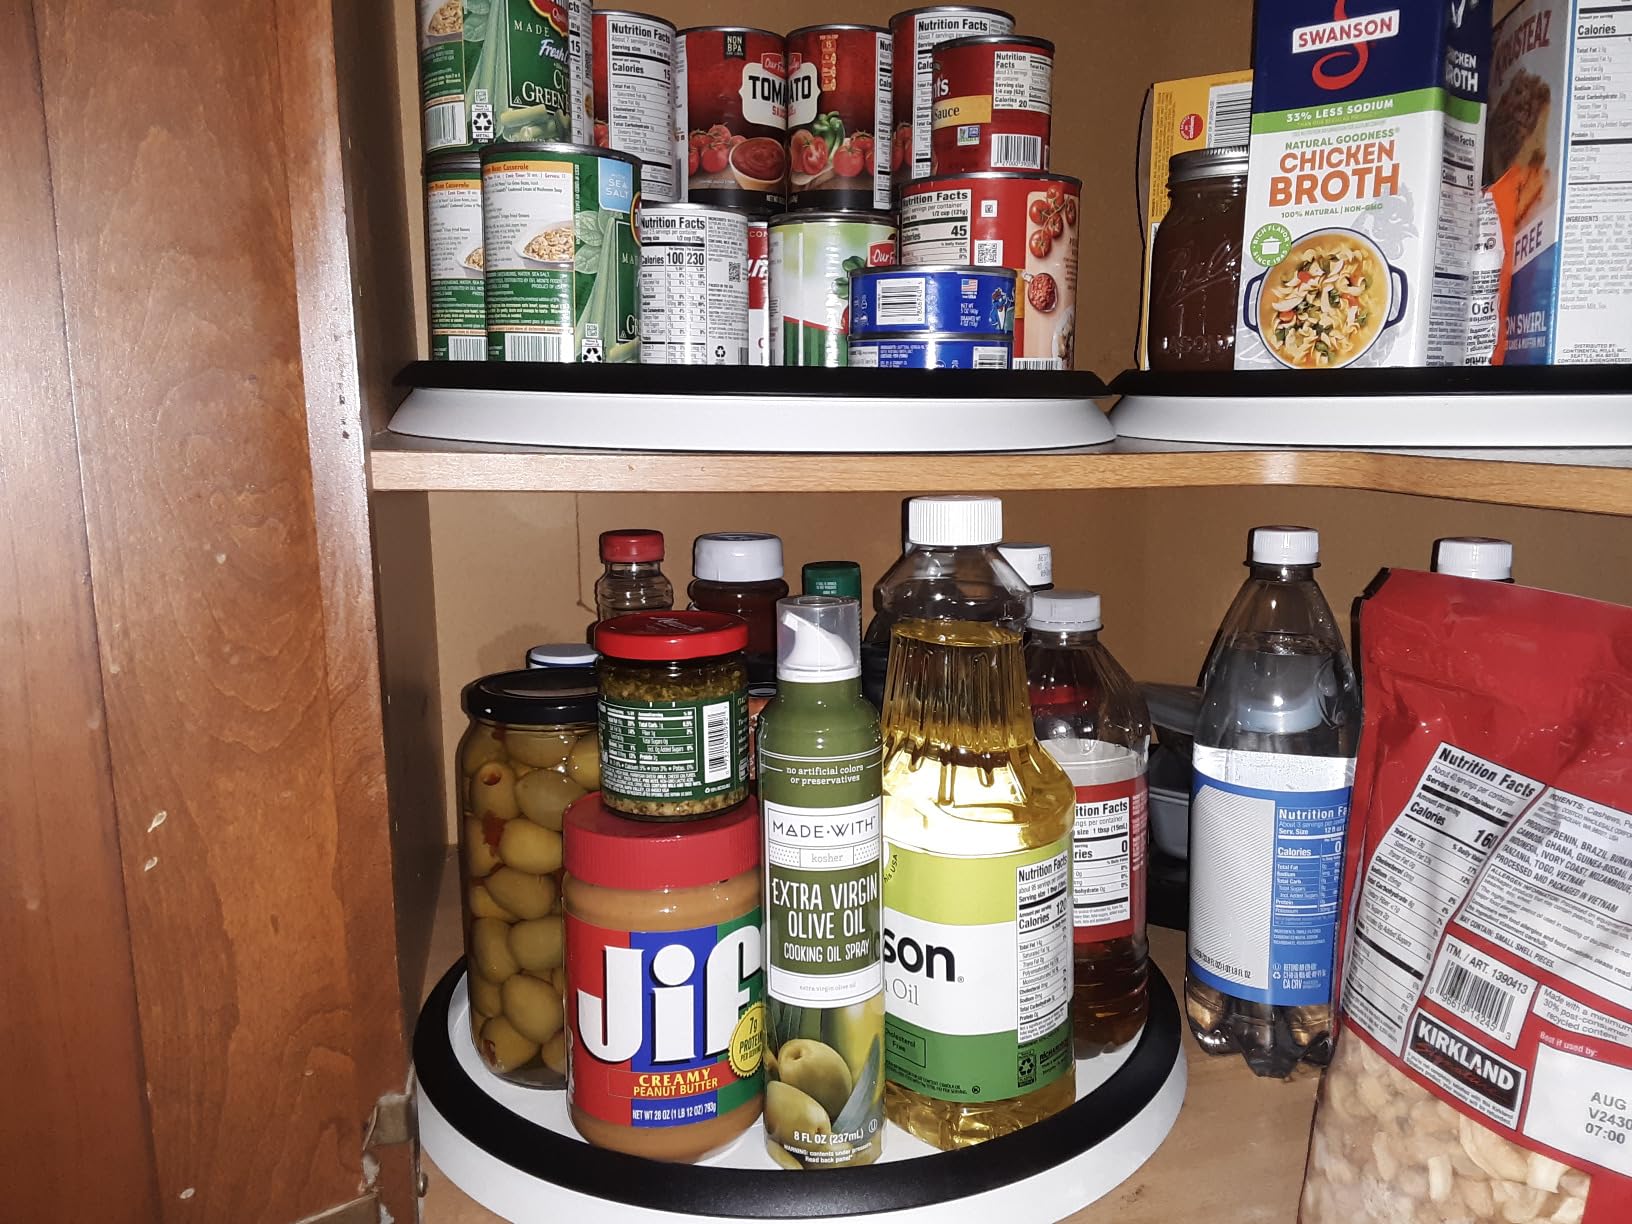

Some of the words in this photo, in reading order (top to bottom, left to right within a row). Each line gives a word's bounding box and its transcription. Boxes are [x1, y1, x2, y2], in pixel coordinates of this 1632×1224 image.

[514, 20, 550, 37] MADE
[612, 23, 652, 38] Nutrition
[653, 29, 671, 44] Facts
[918, 17, 960, 32] Nutrition
[961, 18, 988, 31] Facts
[1298, 16, 1393, 48] SWANSON
[1577, 24, 1617, 36] Calories
[570, 40, 581, 54] 15
[727, 35, 743, 44] NON
[727, 44, 742, 52] BPA
[996, 52, 1027, 61] Nutrition
[996, 60, 1015, 69] Facts
[612, 62, 644, 74] Calories
[663, 68, 671, 81] 15
[1018, 100, 1028, 108] 20
[1286, 111, 1312, 123] 33%
[1315, 106, 1343, 119] LESS
[1346, 98, 1394, 114] SODIUM
[1285, 136, 1333, 150] NATURAL
[1335, 128, 1394, 144] GOODNESS
[1279, 139, 1396, 174] CHICKEN
[608, 178, 627, 187] SEA
[1268, 162, 1401, 208] BROTH
[606, 187, 629, 198] SALT
[936, 190, 968, 201] Facts
[1280, 210, 1303, 219] 100%
[1304, 207, 1339, 218] NATURAL
[679, 216, 706, 230] Facts
[950, 224, 968, 237] 45
[1252, 226, 1267, 245] RICH
[1267, 225, 1290, 243] FLAVOR
[1514, 220, 1544, 266] FREE
[666, 251, 684, 265] 100
[686, 252, 705, 266] 230
[872, 248, 889, 264] Our
[1516, 310, 1548, 335] SWIRL
[786, 766, 797, 775] no
[797, 765, 839, 776] artificial
[839, 763, 864, 774] colors
[1438, 747, 1498, 783] Nutrition
[1498, 773, 1536, 799] Facts
[790, 776, 799, 784] or
[801, 774, 860, 787] preservatives
[1075, 804, 1100, 817] ition
[1102, 799, 1128, 815] Facts
[1279, 808, 1334, 820] Nutrition
[1088, 818, 1099, 828] per
[1098, 815, 1123, 825] container
[1295, 827, 1309, 835] Size
[1409, 801, 1447, 826] Calories
[1473, 828, 1499, 850] 160
[1121, 839, 1128, 853] 0
[1277, 846, 1312, 857] Calories
[1334, 840, 1342, 853] 0
[1553, 830, 1580, 849] BENIN,
[811, 852, 844, 864] kosher
[1544, 839, 1575, 860] GHANA,
[890, 854, 898, 873] USA
[1018, 862, 1053, 883] Nutrition
[1053, 854, 1068, 872] Facts
[1533, 859, 1556, 877] TOGO,
[1541, 849, 1567, 867] IVORY
[1564, 859, 1589, 878] COAST,
[772, 877, 823, 911] EXTRA
[830, 872, 878, 909] VIRGIN
[1494, 852, 1534, 878] PROCESSED
[1532, 872, 1549, 886] AND
[1547, 878, 1583, 898] PACKAGED
[1581, 891, 1589, 901] IN
[1587, 894, 1620, 915] VIETNAM
[788, 910, 835, 940] OLIVE
[843, 906, 866, 937] OIL
[1018, 912, 1050, 930] Calories
[783, 942, 823, 963] COOKING
[827, 943, 842, 962] OIL
[845, 938, 870, 961] SPRAY
[1494, 932, 1515, 949] SMALL
[1515, 942, 1534, 960] SHELL
[1446, 942, 1463, 960] ITM.
[1468, 956, 1490, 976] ART.
[1491, 968, 1530, 995] 1390413
[576, 924, 761, 1063] Jif
[892, 978, 920, 1006] Oil
[1429, 986, 1435, 995] 0
[1505, 1031, 1512, 1041] 3
[1543, 987, 1565, 1005] Made
[1565, 998, 1581, 1013] with
[1589, 1011, 1632, 1034] minimum
[1543, 997, 1561, 1013] 30%
[1560, 1008, 1629, 1039] post-consumer
[1546, 1011, 1580, 1031] recycled
[1581, 1024, 1618, 1042] content
[1539, 1030, 1556, 1045] Best
[1556, 1035, 1563, 1046] if
[1563, 1041, 1584, 1054] used
[1584, 1046, 1599, 1058] by:
[1417, 1019, 1516, 1092] KIRKLAND
[633, 1085, 677, 1098] PEANUT
[679, 1075, 719, 1095] BUTTER
[638, 1067, 711, 1087] CREAMY
[1590, 1091, 1628, 1111] AUG
[632, 1108, 643, 1120] NET
[643, 1109, 654, 1120] WT
[654, 1108, 662, 1120] 28
[662, 1108, 671, 1120] OZ
[677, 1106, 686, 1118] LB
[686, 1105, 693, 1117] 12
[793, 1130, 800, 1142] 8
[801, 1132, 812, 1144] FL
[814, 1133, 827, 1145] OZ
[829, 1127, 864, 1146] (237mL)
[1585, 1122, 1627, 1145] 07:00
